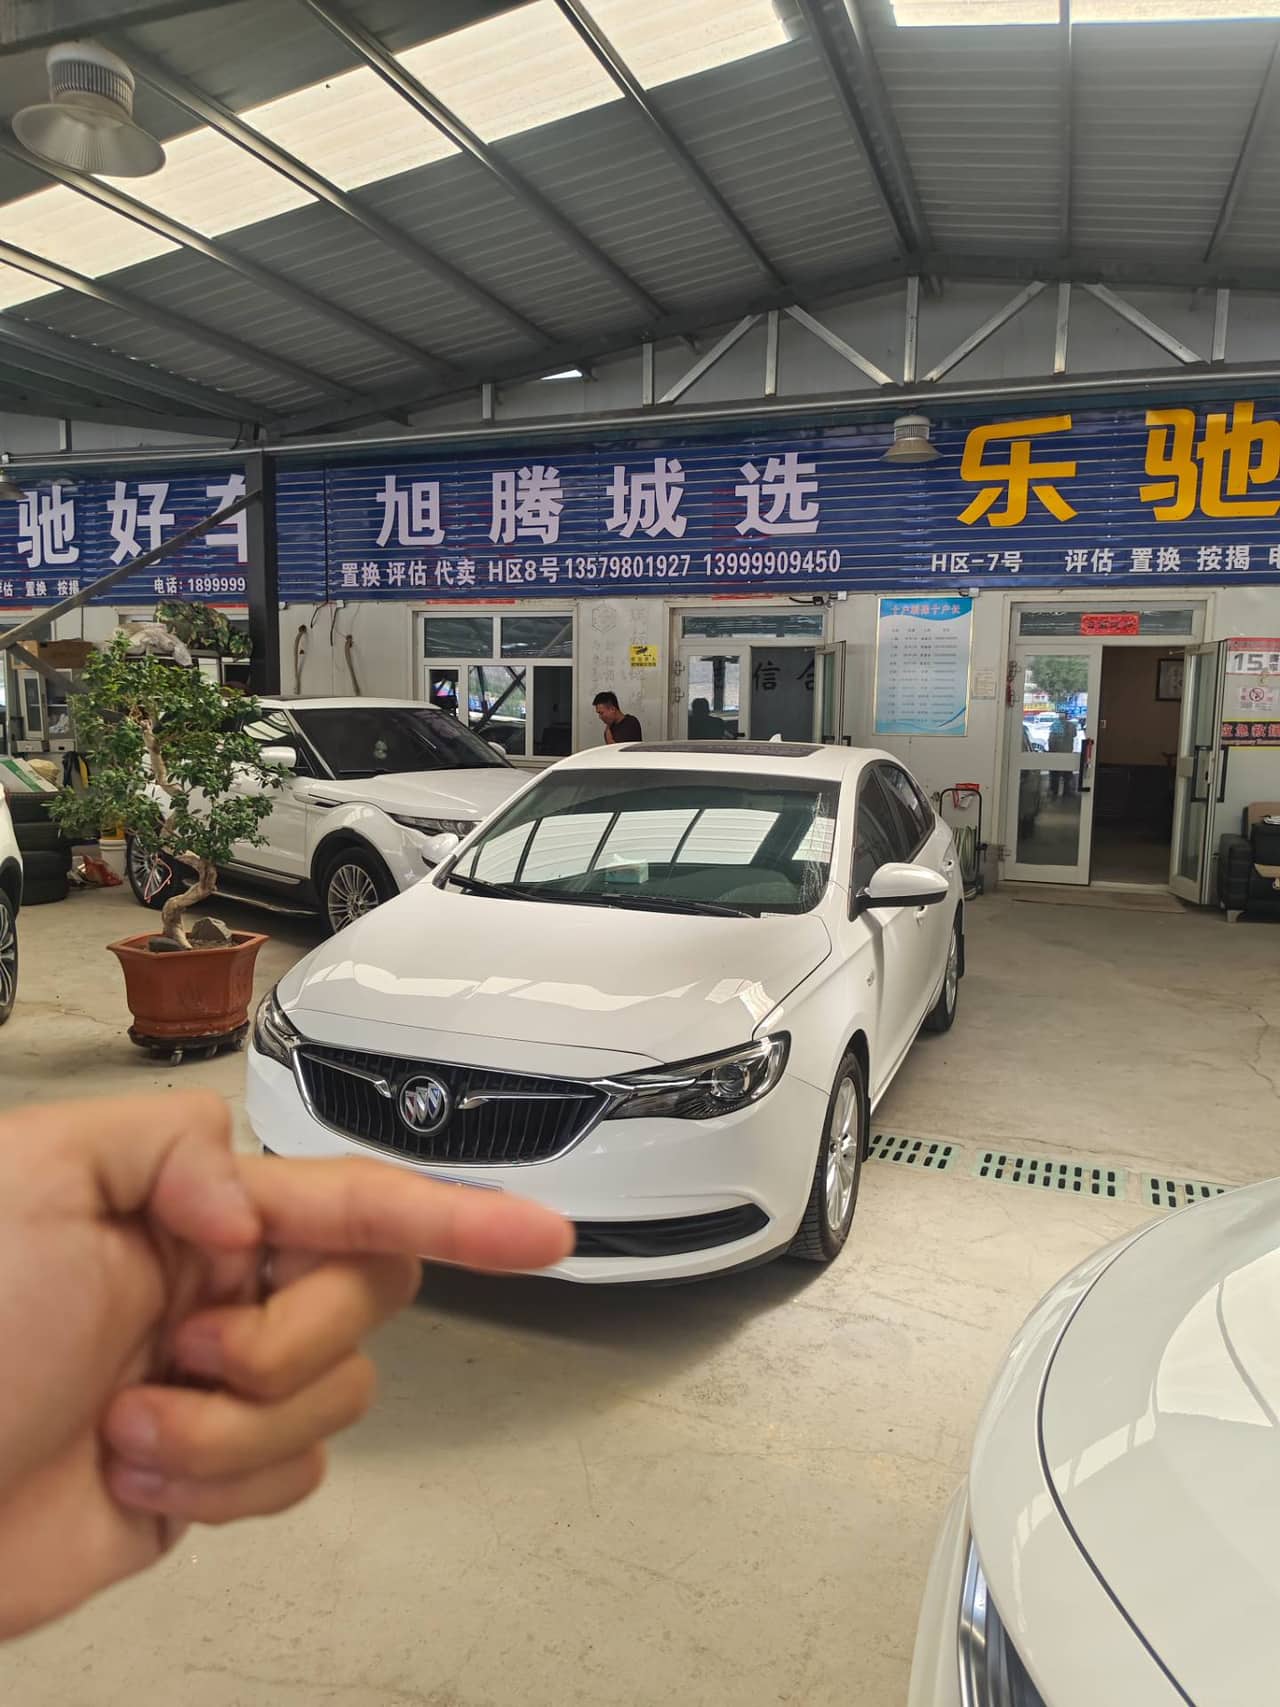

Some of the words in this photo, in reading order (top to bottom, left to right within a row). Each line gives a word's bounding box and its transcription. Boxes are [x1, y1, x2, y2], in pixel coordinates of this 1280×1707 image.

[957, 400, 1280, 526] 乐驰
[376, 452, 820, 547] 旭腾城选
[341, 562, 381, 588] 置换
[386, 560, 428, 586] 评估
[434, 559, 477, 585] 代卖
[489, 556, 560, 583] H区8号
[565, 554, 691, 580] 13579801927
[703, 549, 841, 577] 13999909450
[931, 551, 1023, 573] H区-7号
[1065, 548, 1115, 574] 评估
[1129, 547, 1181, 573] 置换
[1197, 545, 1250, 571] 按揭
[25, 580, 47, 597] 置换
[187, 576, 246, 592] 1899999
